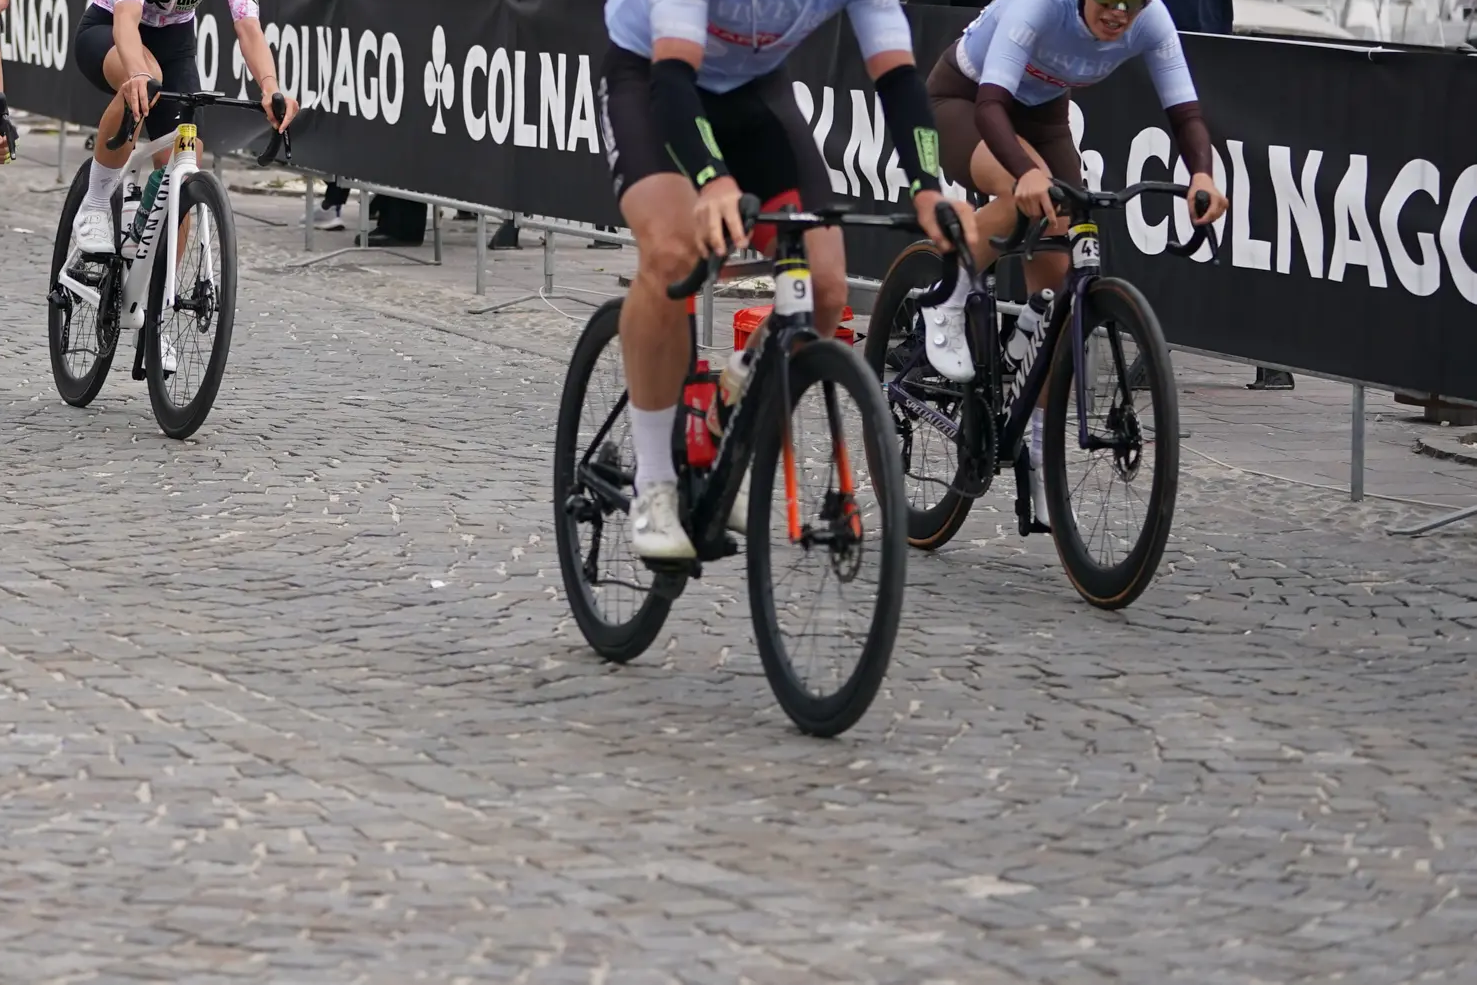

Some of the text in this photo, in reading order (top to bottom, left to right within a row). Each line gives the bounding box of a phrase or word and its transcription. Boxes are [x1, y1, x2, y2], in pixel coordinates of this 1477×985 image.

[463, 45, 600, 154] COLNA
[136, 174, 170, 259] CANYON
[793, 279, 807, 300] 9
[904, 398, 957, 440] SPECIALIZED
